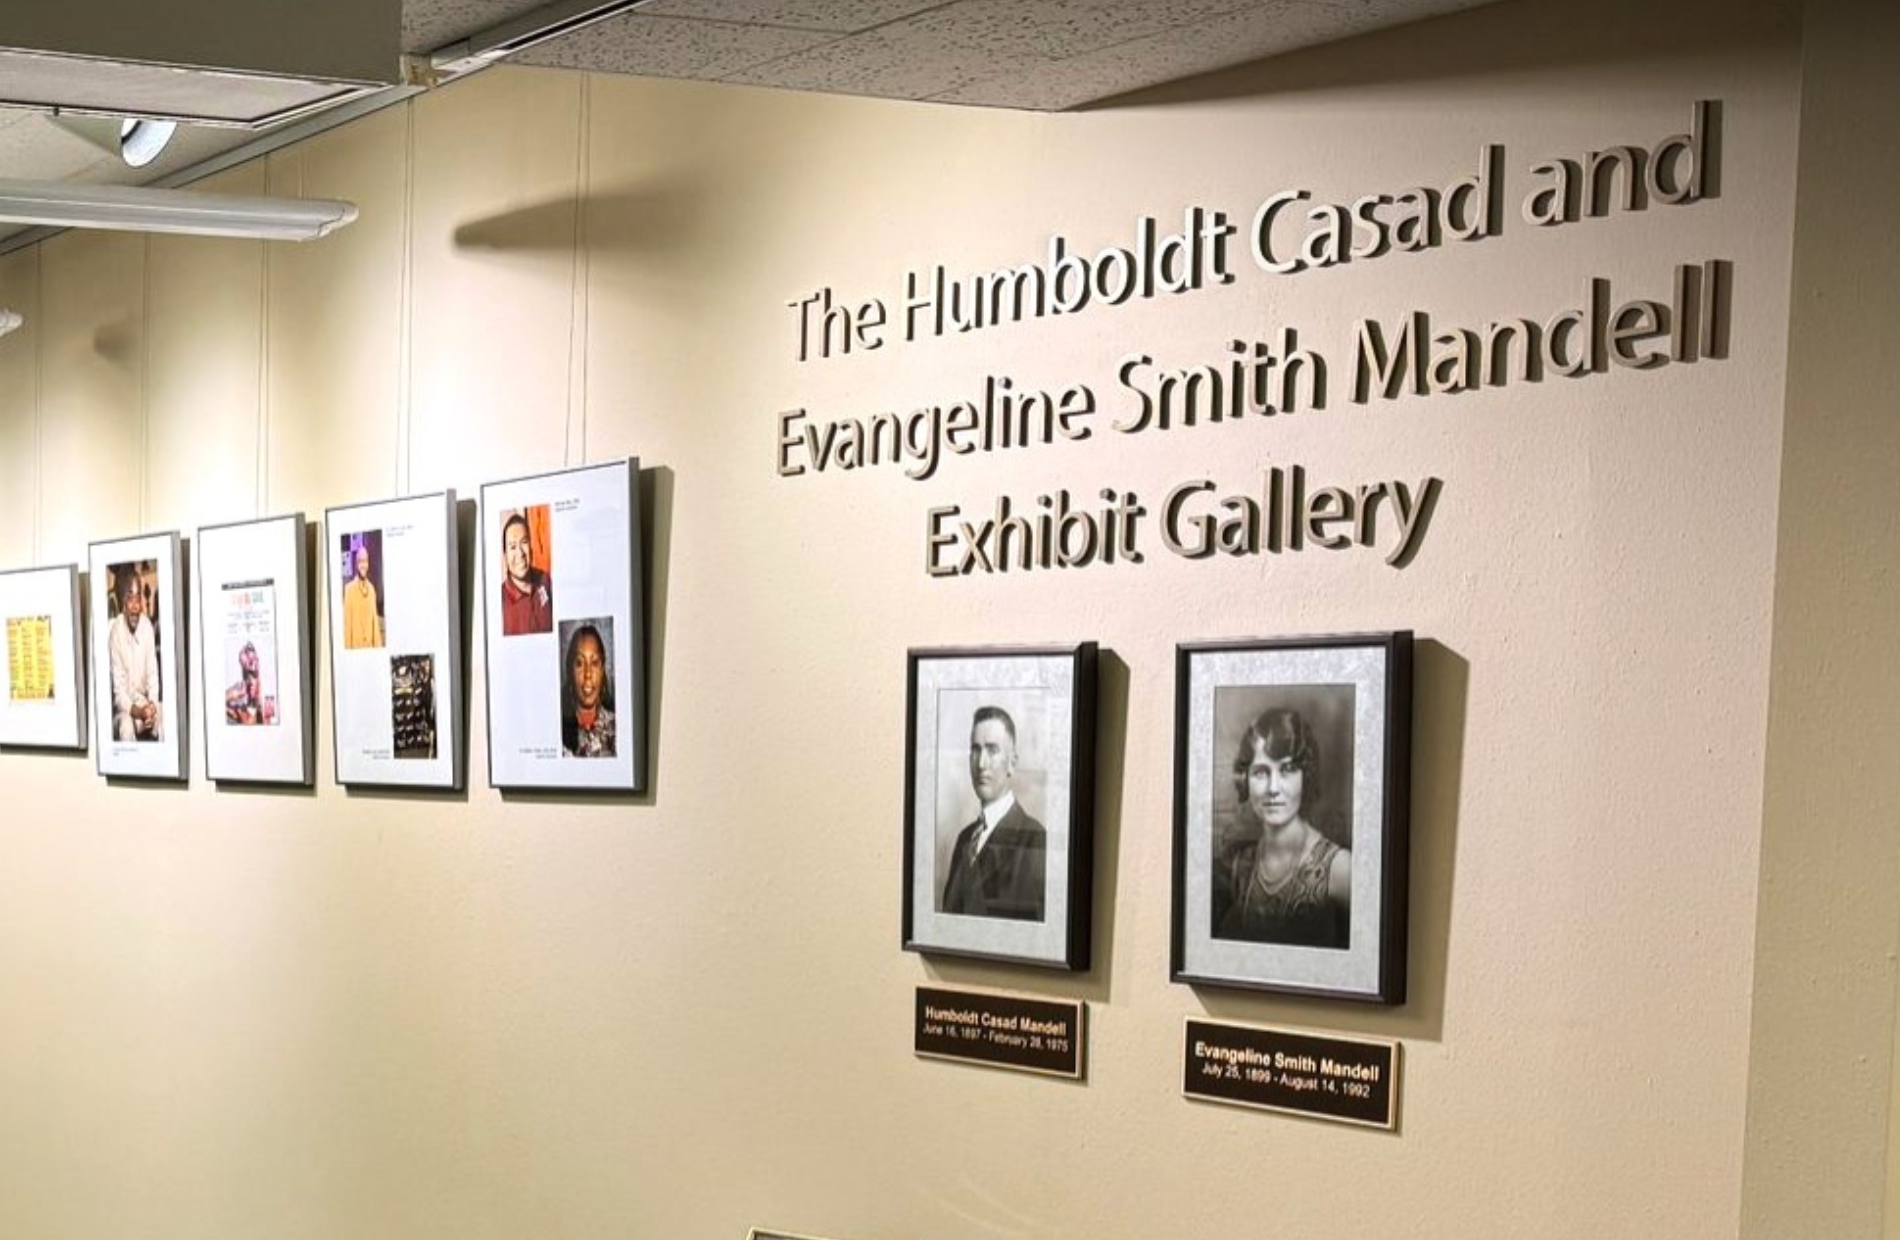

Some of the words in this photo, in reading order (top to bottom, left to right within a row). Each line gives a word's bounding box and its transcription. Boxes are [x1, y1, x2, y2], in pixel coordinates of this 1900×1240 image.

[788, 288, 885, 361] The
[903, 208, 1237, 341] Humboldt
[1251, 144, 1504, 275] Casad
[1521, 100, 1721, 226] and
[777, 376, 1095, 479] Evangeline
[1112, 328, 1325, 434] Smith
[1350, 260, 1733, 404] Mandell
[925, 490, 1145, 577] Exhibit
[1160, 465, 1441, 569] Gallery
[923, 1022, 943, 1035] June
[988, 1031, 1027, 1048] February
[925, 1006, 978, 1026] Humboldt
[981, 1012, 1017, 1030] Casad
[1020, 1017, 1066, 1036] Mandell
[1195, 1041, 1271, 1067] Evangeline
[1274, 1052, 1317, 1073] Smith
[1320, 1058, 1380, 1082] Mandell
[1202, 1063, 1223, 1078] July
[1225, 1065, 1242, 1080] 25,
[1245, 1068, 1271, 1084] 1899
[1280, 1073, 1319, 1091] August
[1322, 1079, 1339, 1095] 14,
[1342, 1082, 1371, 1099] 1992
